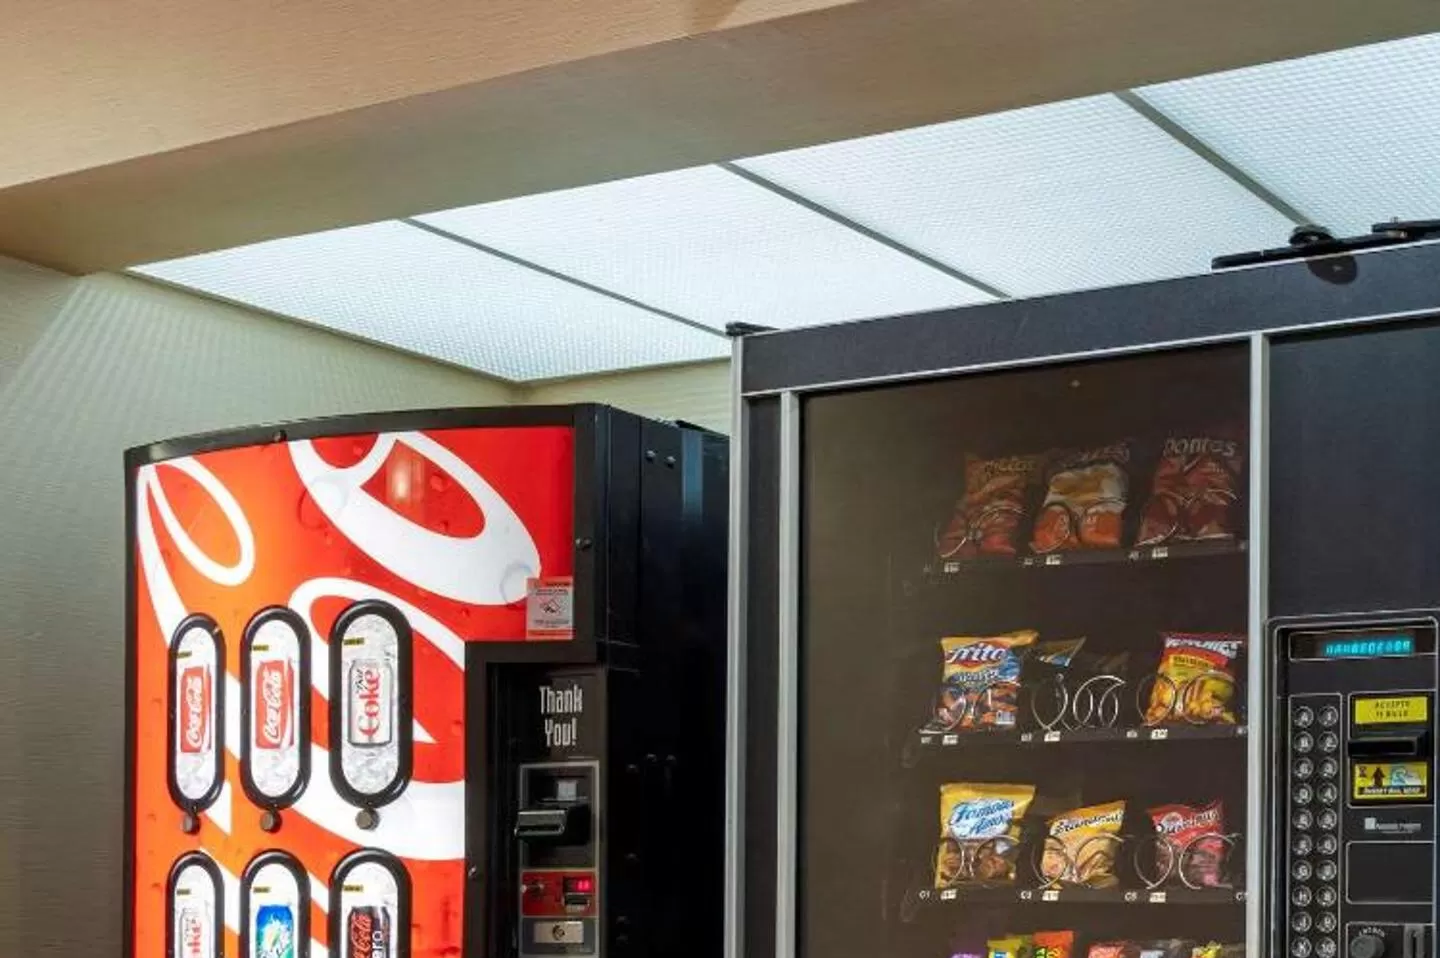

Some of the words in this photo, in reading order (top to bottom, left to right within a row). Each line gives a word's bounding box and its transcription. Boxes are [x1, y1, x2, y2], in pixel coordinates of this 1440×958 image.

[358, 669, 381, 738] Coke
[539, 684, 584, 714] Thank
[544, 717, 578, 747] You!
